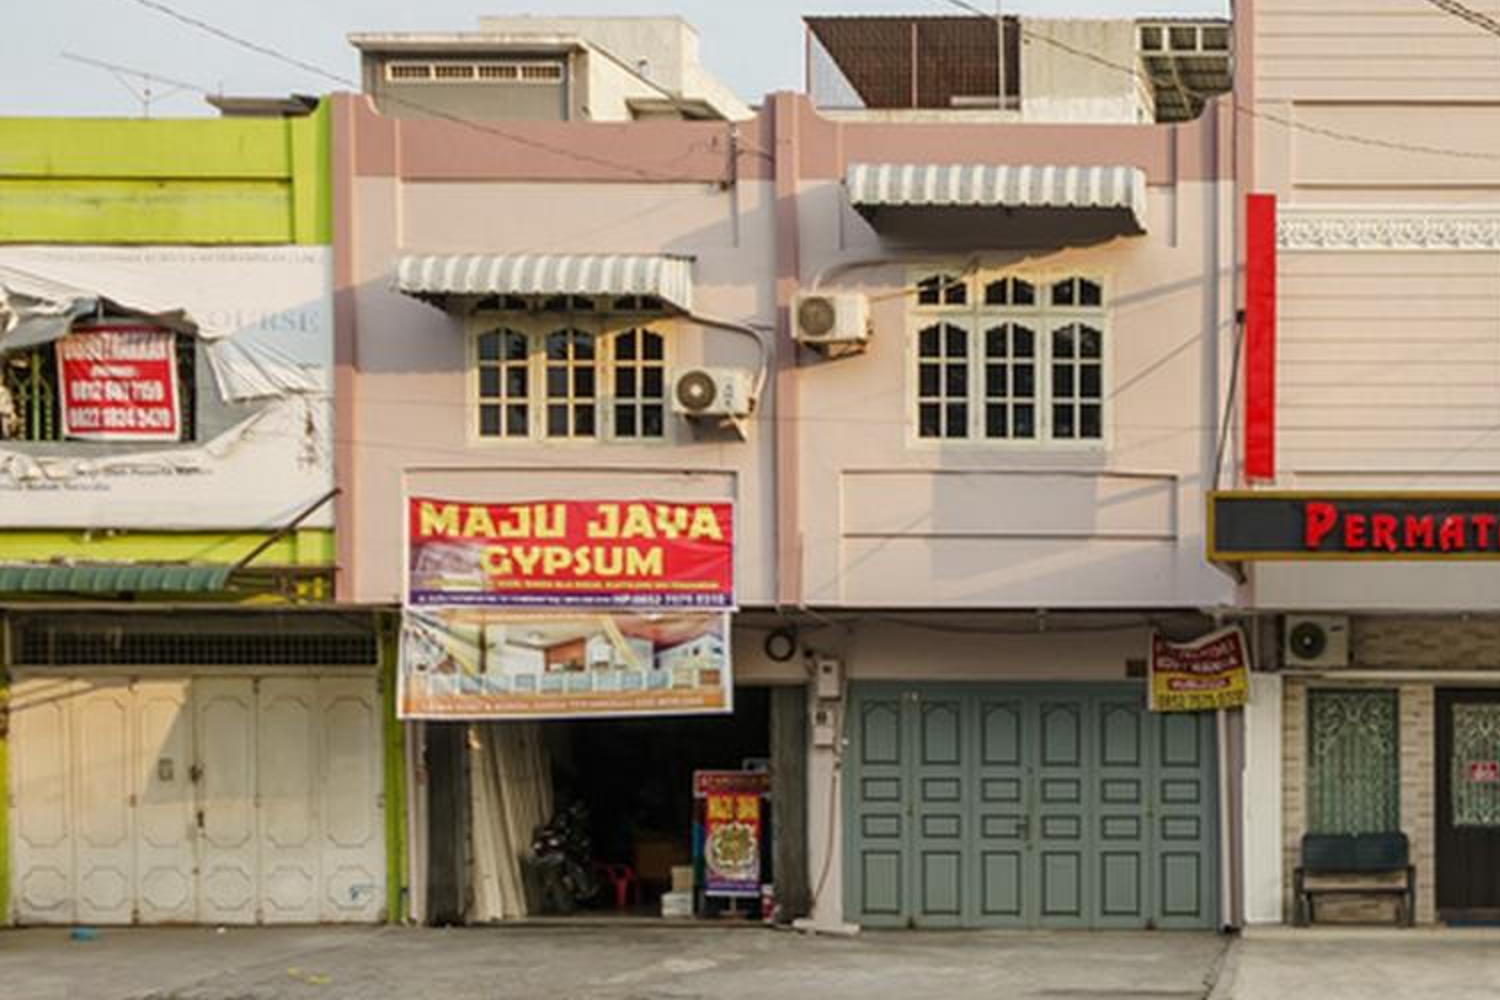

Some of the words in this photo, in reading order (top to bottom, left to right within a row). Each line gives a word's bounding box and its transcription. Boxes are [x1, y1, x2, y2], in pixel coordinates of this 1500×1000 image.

[420, 502, 566, 538] MAJU
[587, 504, 723, 540] JAYA
[480, 546, 663, 576] GYPSUM
